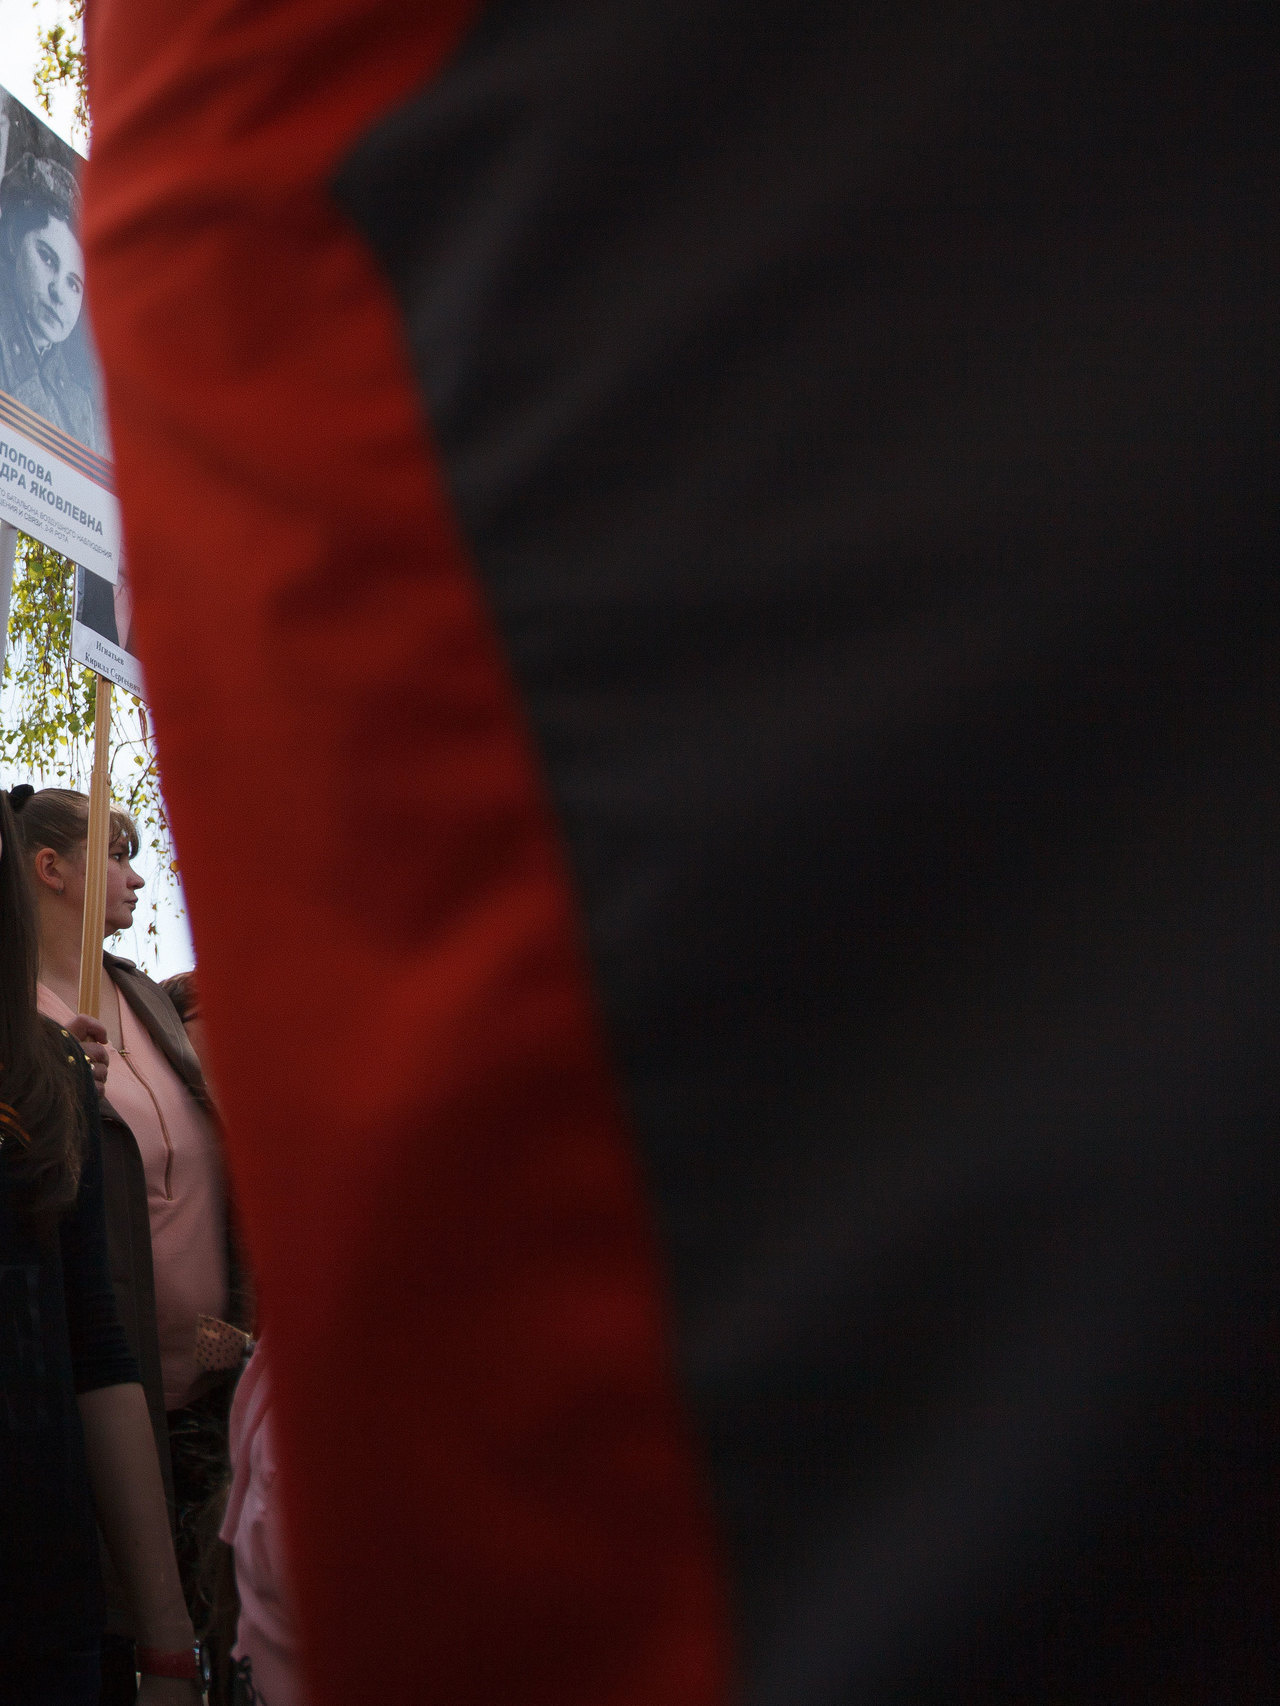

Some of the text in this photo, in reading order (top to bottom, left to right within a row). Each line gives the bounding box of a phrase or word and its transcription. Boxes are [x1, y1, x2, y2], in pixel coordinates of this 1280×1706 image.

[0, 441, 52, 485] ПОПОВА
[30, 482, 103, 535] ЯКОВЛЕВНА
[85, 652, 109, 675] Кирилл
[96, 641, 124, 665] Игнатьев
